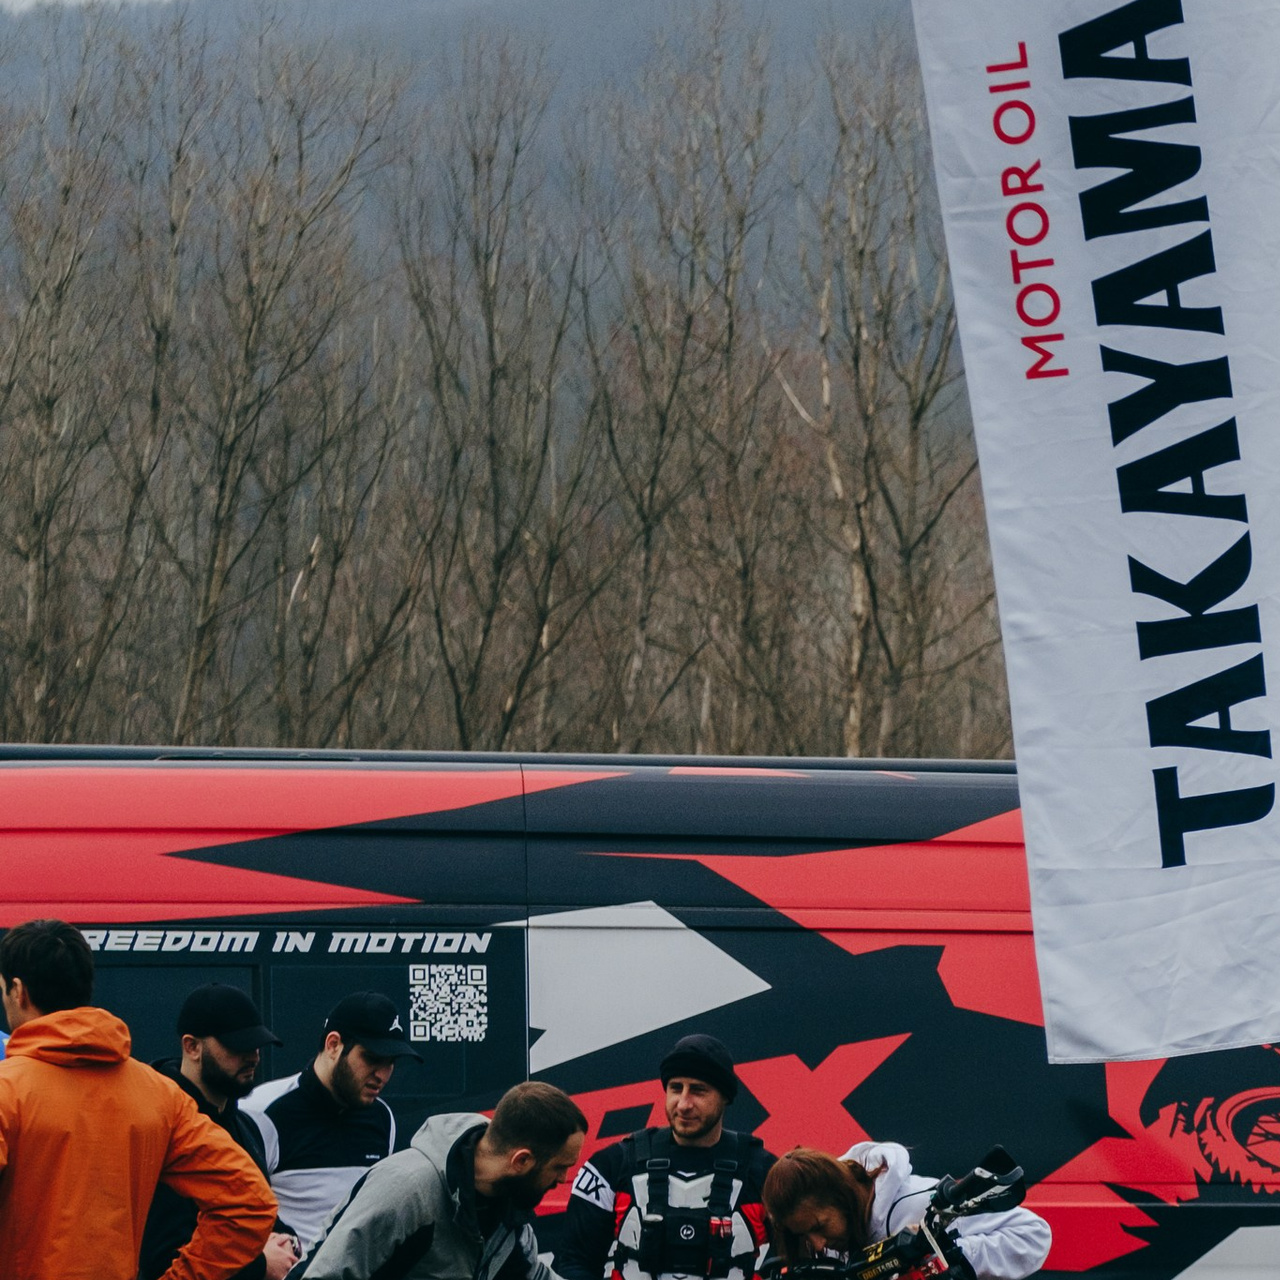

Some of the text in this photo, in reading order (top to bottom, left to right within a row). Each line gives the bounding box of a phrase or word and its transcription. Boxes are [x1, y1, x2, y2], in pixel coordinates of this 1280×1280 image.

[985, 41, 1070, 380] MOTOR OIL
[80, 930, 493, 954] REEDOM IN MOTION
